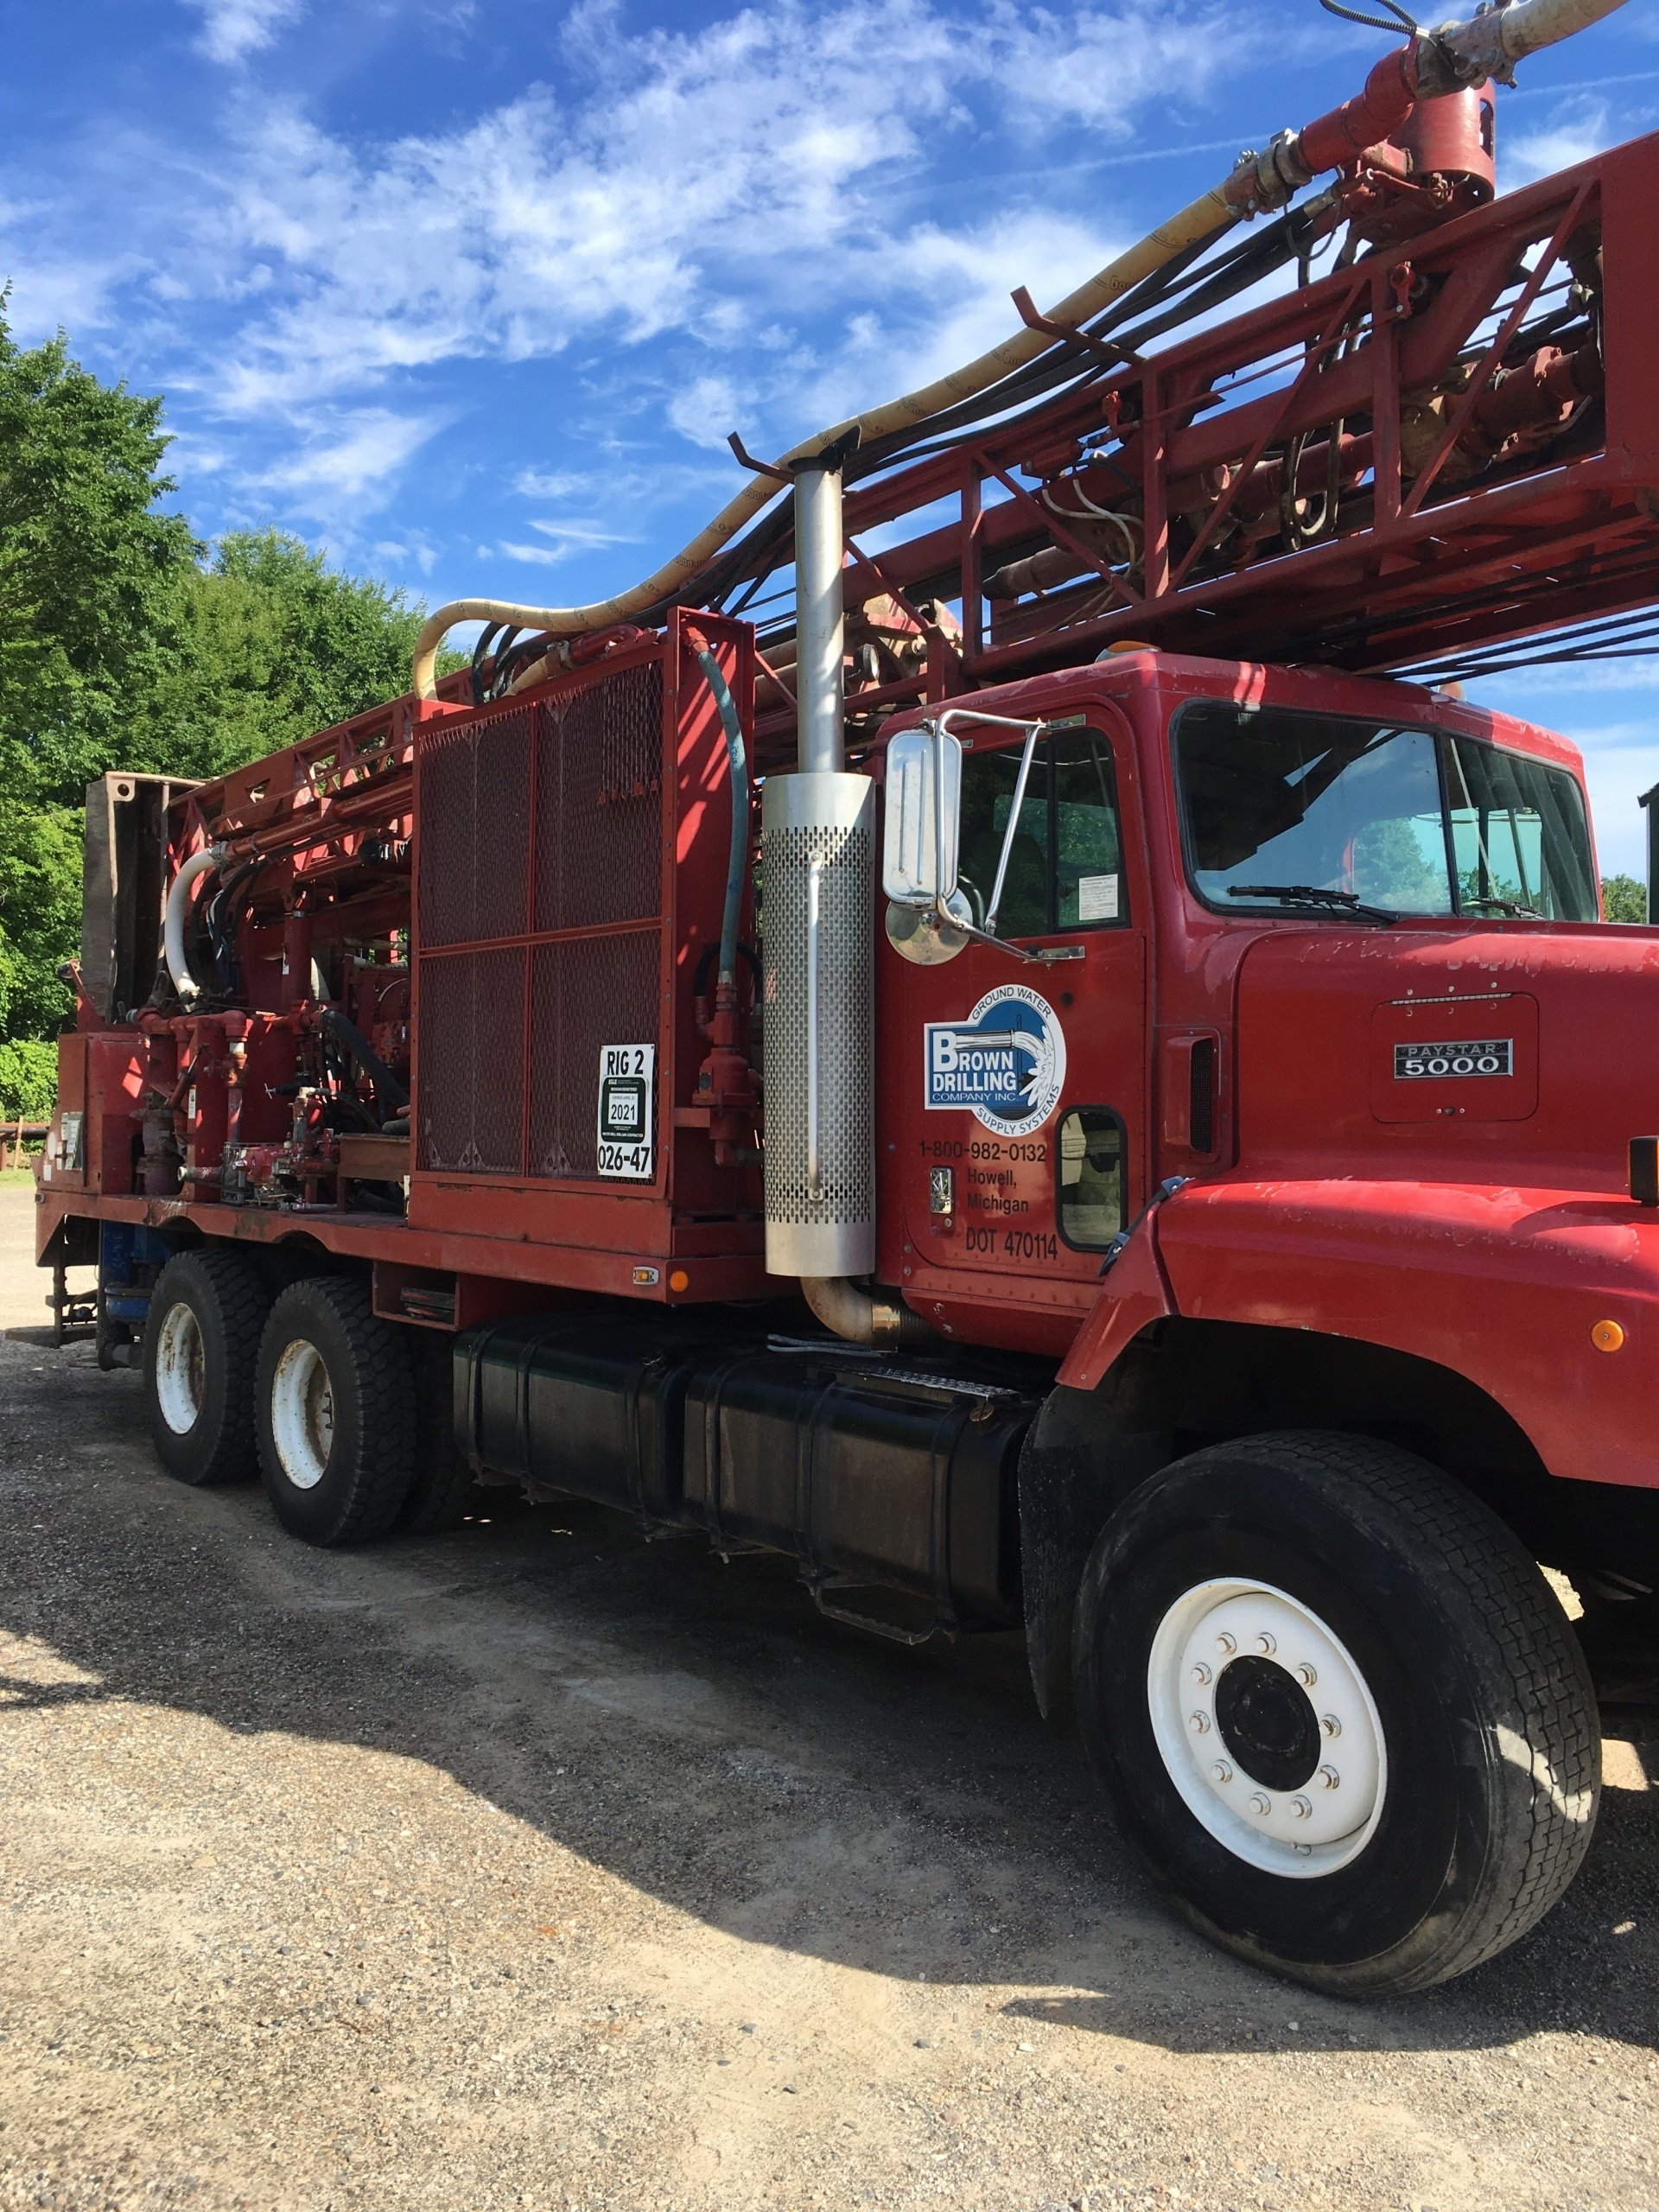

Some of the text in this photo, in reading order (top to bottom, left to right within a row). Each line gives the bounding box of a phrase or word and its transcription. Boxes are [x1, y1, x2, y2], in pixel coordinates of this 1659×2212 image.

[972, 987, 1052, 1020] GROUND WATER
[1408, 1043, 1496, 1057] PAYSTAR
[607, 1050, 644, 1076] RIG 2
[1404, 1056, 1499, 1076] 5000
[933, 1071, 1016, 1092] DRILLING
[932, 1092, 1019, 1102] COMPANY INC.
[611, 1104, 635, 1121] 2021
[976, 1084, 1059, 1135] SUPPLY SYSTEMS
[598, 1145, 650, 1172] 026-47
[919, 1141, 1046, 1162] 1-800-982-0132
[967, 1169, 1017, 1189] Howell,
[967, 1193, 1029, 1214] Michigan
[966, 1227, 1058, 1260] DOT 470114
